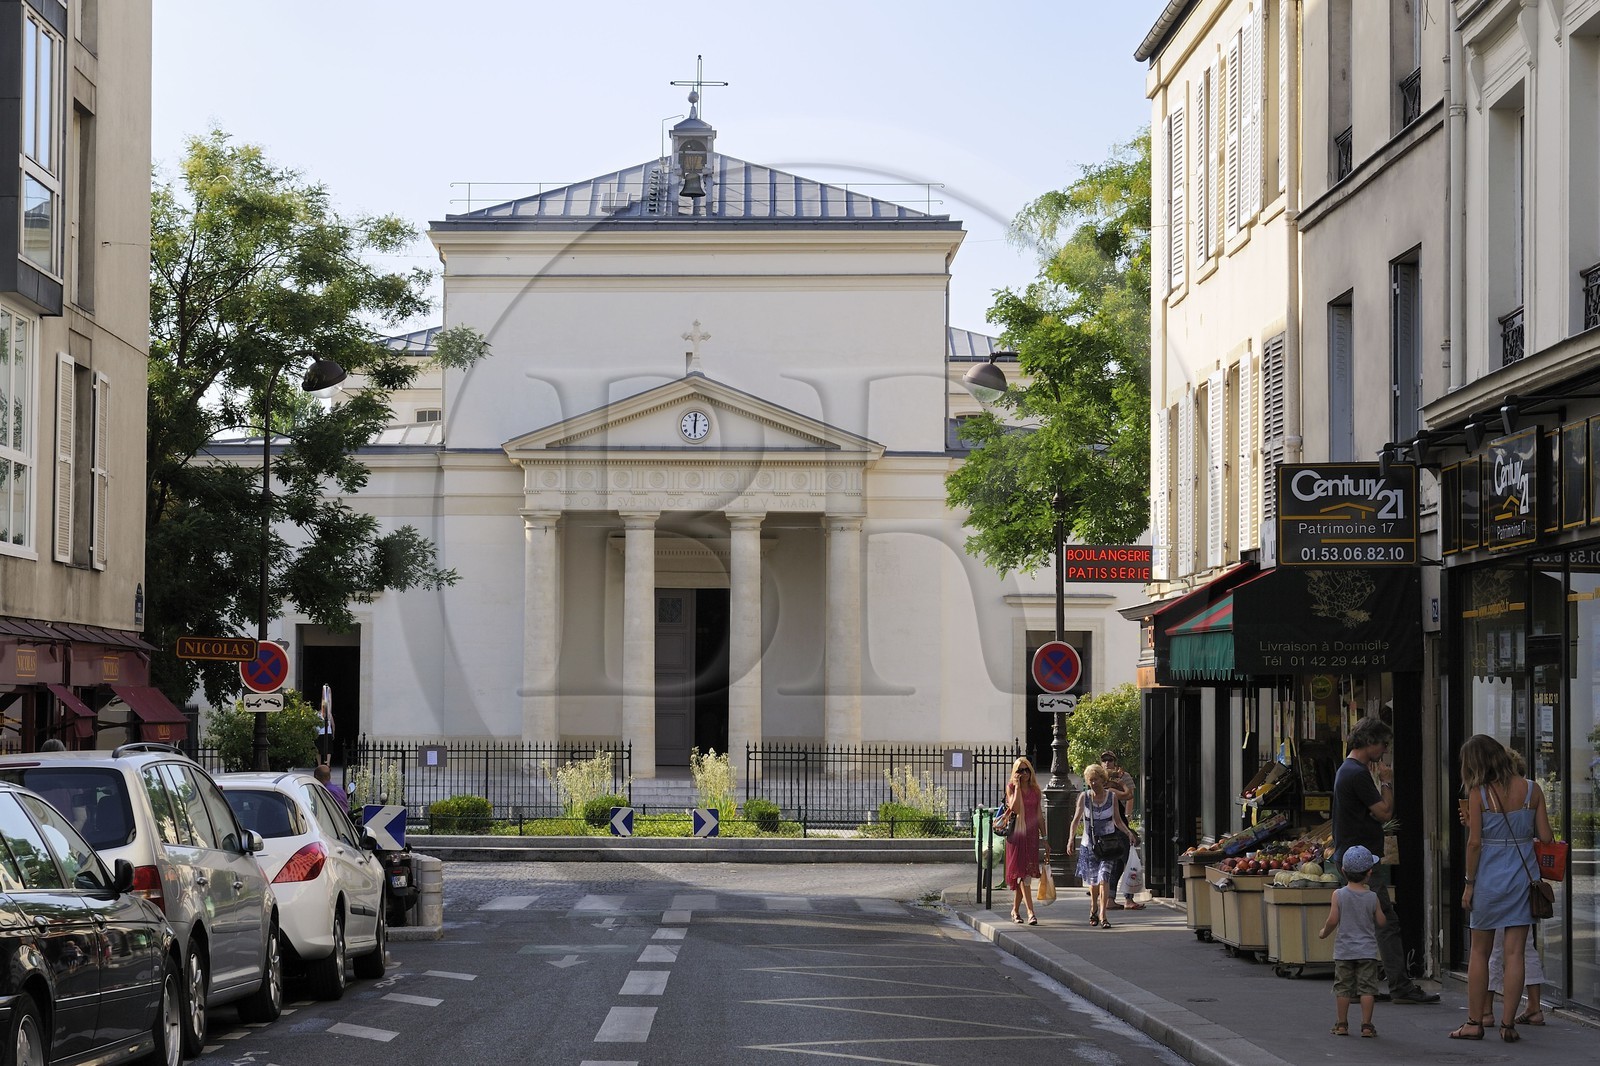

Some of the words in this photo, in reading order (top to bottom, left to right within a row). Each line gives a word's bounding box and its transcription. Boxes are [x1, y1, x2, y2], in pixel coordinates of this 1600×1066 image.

[1494, 454, 1524, 496] Century
[1291, 469, 1387, 502] Century
[1519, 472, 1529, 515] 21
[779, 498, 817, 509] MARIA
[1376, 489, 1404, 520] 21
[1298, 522, 1376, 534] Patrimoine
[1381, 522, 1395, 533] 17
[1066, 549, 1150, 562] BOULANGERIE
[1301, 547, 1405, 561] 01.53.06.82.10
[1068, 567, 1150, 579] PATISSERIE
[184, 641, 249, 656] NICOLAS
[1259, 640, 1318, 652] Livraison
[1321, 640, 1329, 651] à
[1334, 640, 1390, 651] Domicile
[17, 654, 36, 672] NICOLAS
[1262, 655, 1282, 666] Tél
[1290, 656, 1305, 666] 01
[1310, 656, 1327, 666] 42
[1331, 656, 1347, 666] 29
[1351, 655, 1367, 666] 44
[1371, 654, 1386, 665] 81
